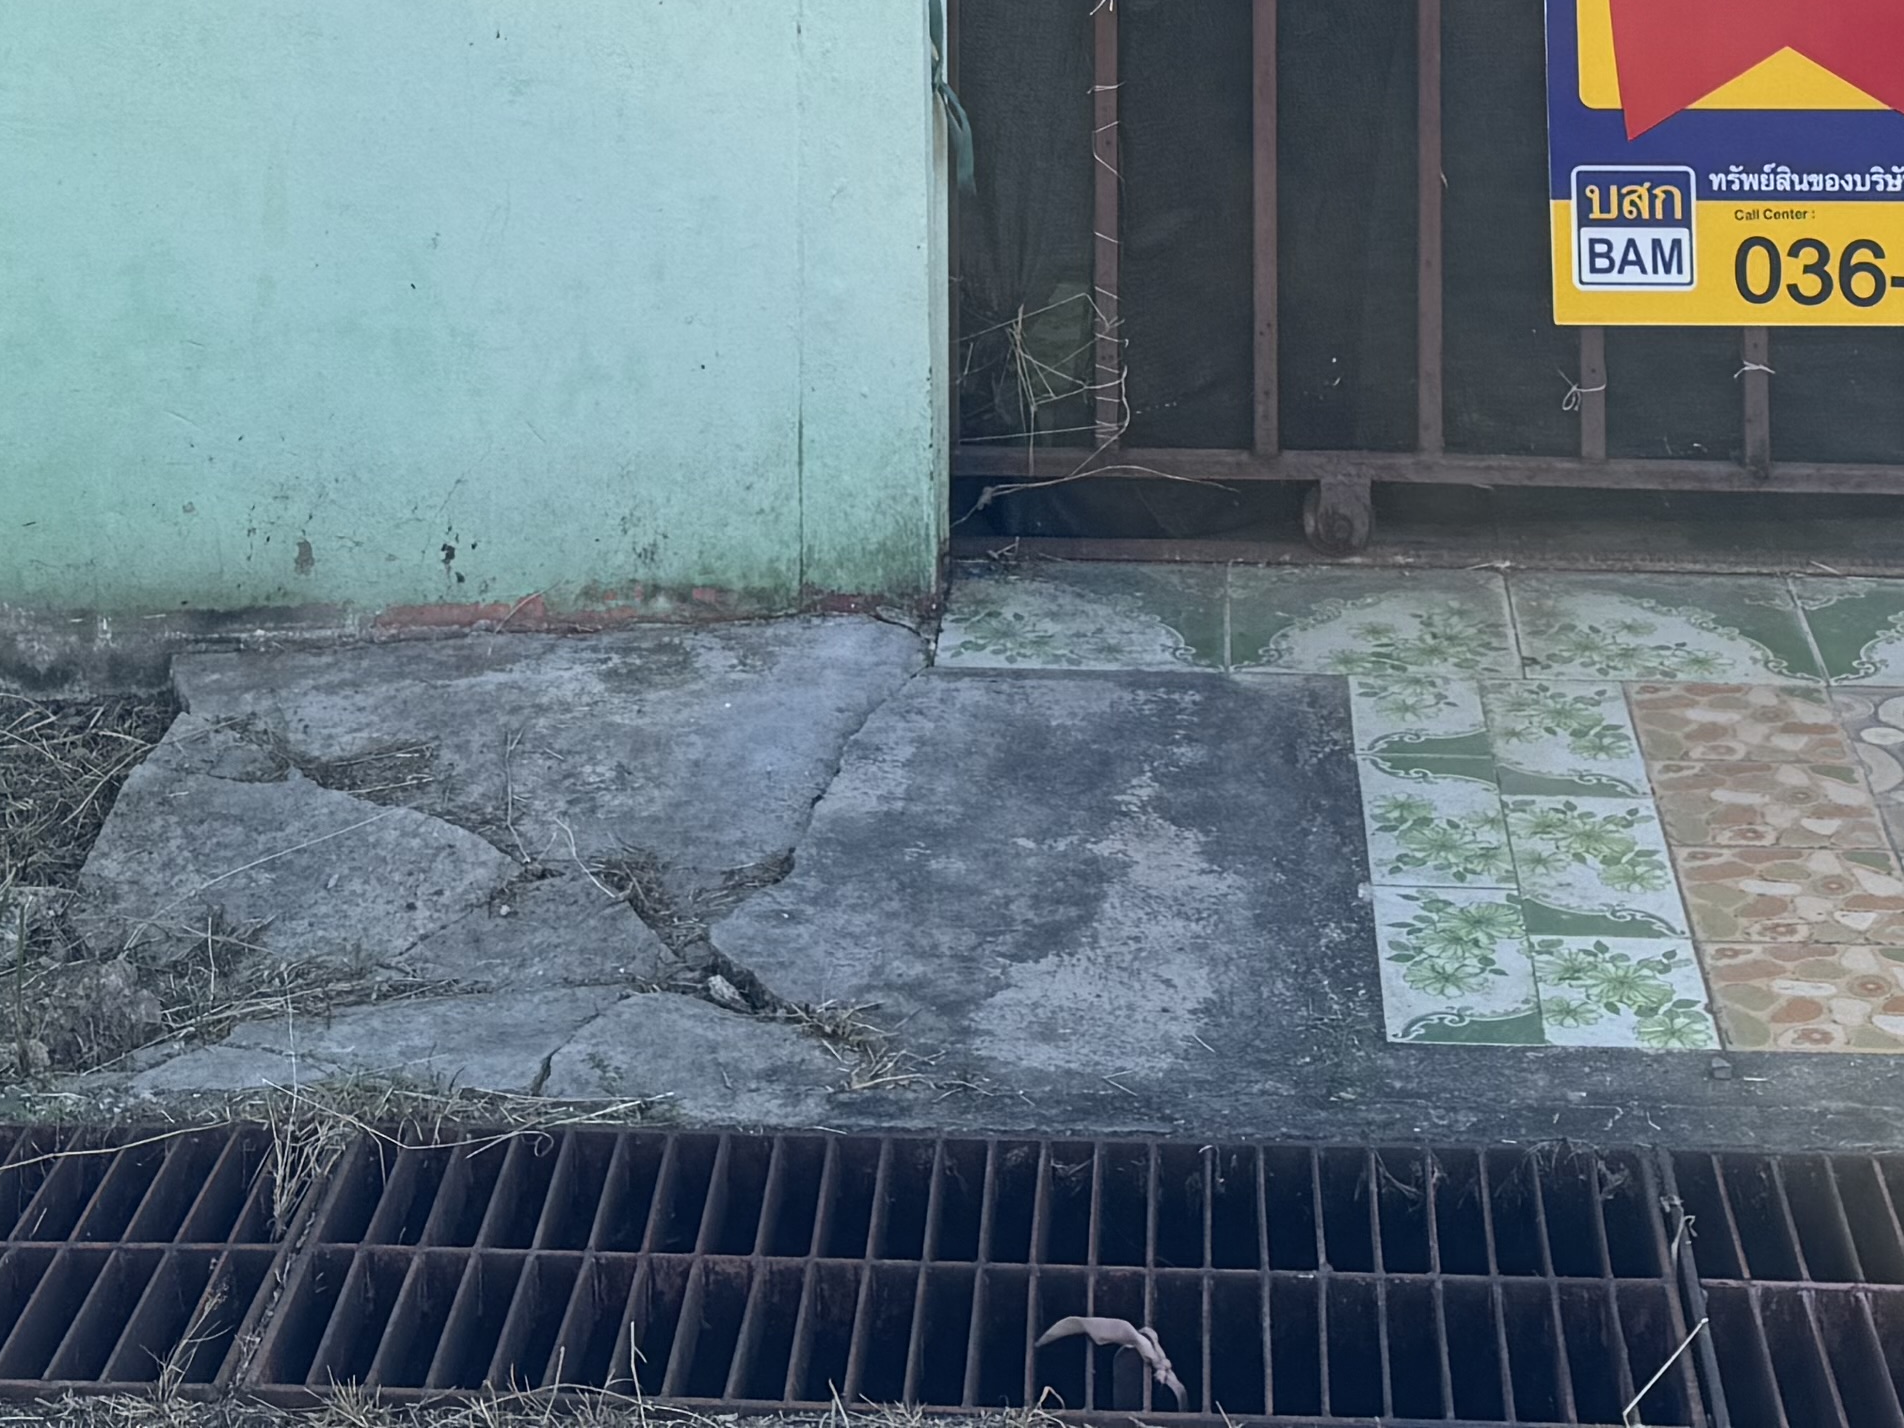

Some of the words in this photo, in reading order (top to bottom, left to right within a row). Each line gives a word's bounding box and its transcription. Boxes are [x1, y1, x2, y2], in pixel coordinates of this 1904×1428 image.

[1584, 182, 1683, 221] บสก
[1734, 209, 1760, 221] Call
[1588, 237, 1683, 276] BAM
